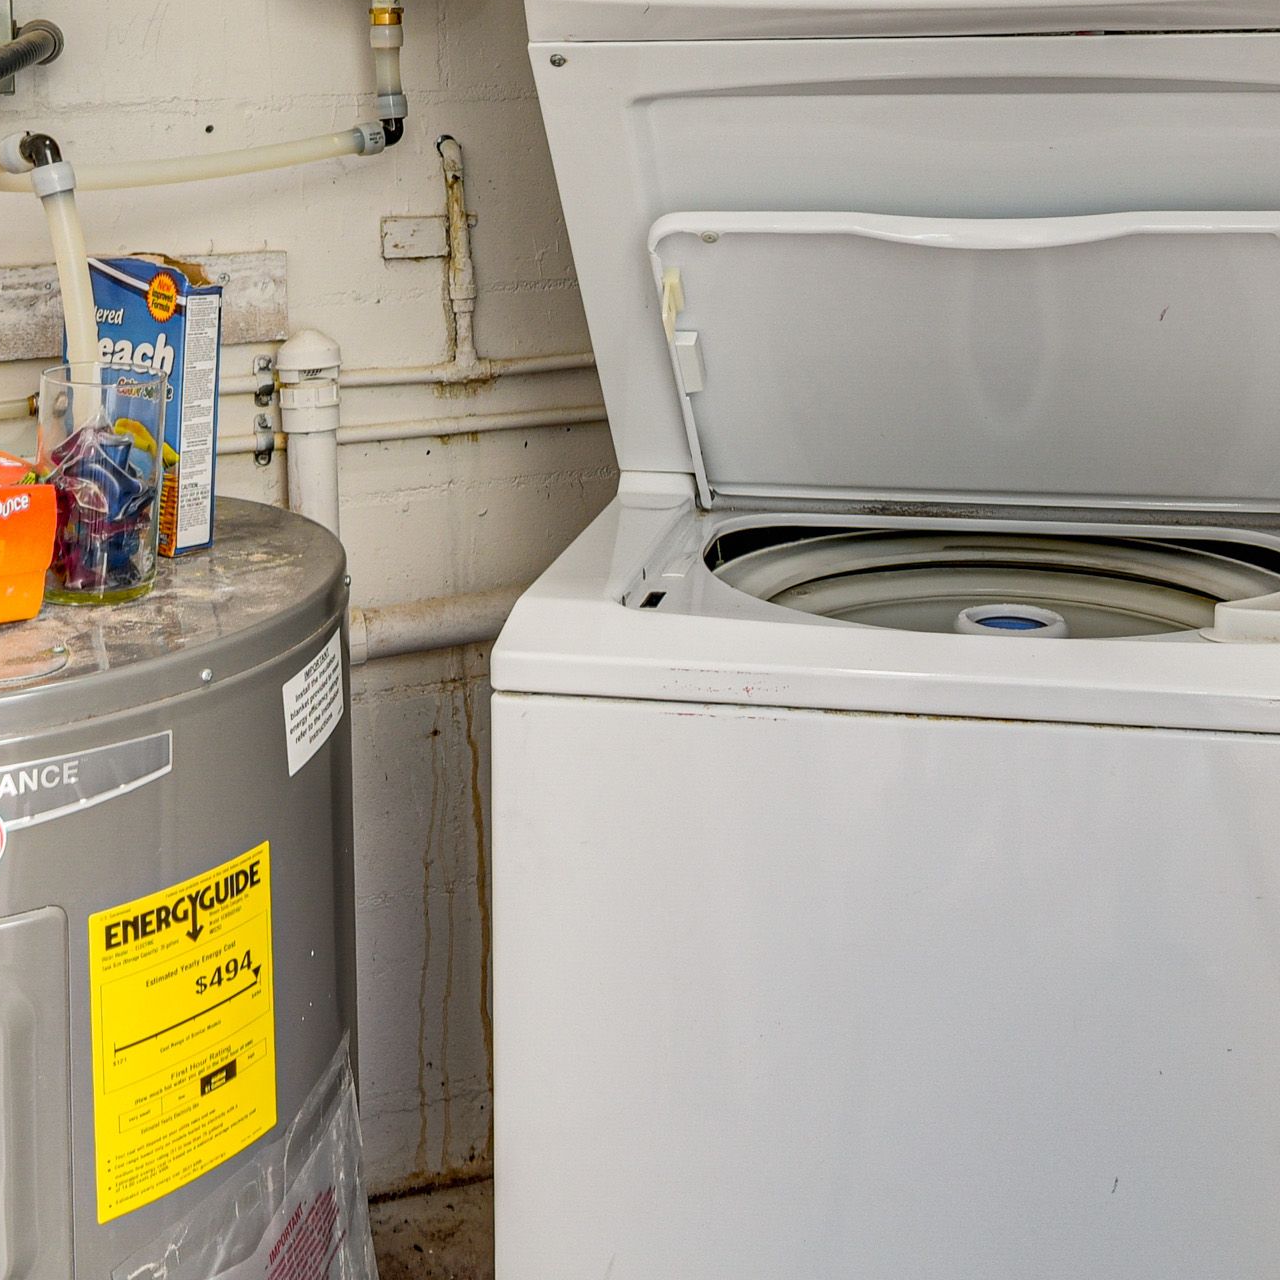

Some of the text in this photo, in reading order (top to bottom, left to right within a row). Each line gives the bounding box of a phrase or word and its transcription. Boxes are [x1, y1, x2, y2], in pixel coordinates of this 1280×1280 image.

[146, 940, 236, 987] Estimated Yearly Energy Cost
[195, 949, 253, 995] $494
[170, 1044, 232, 1080] First Hour Rating
